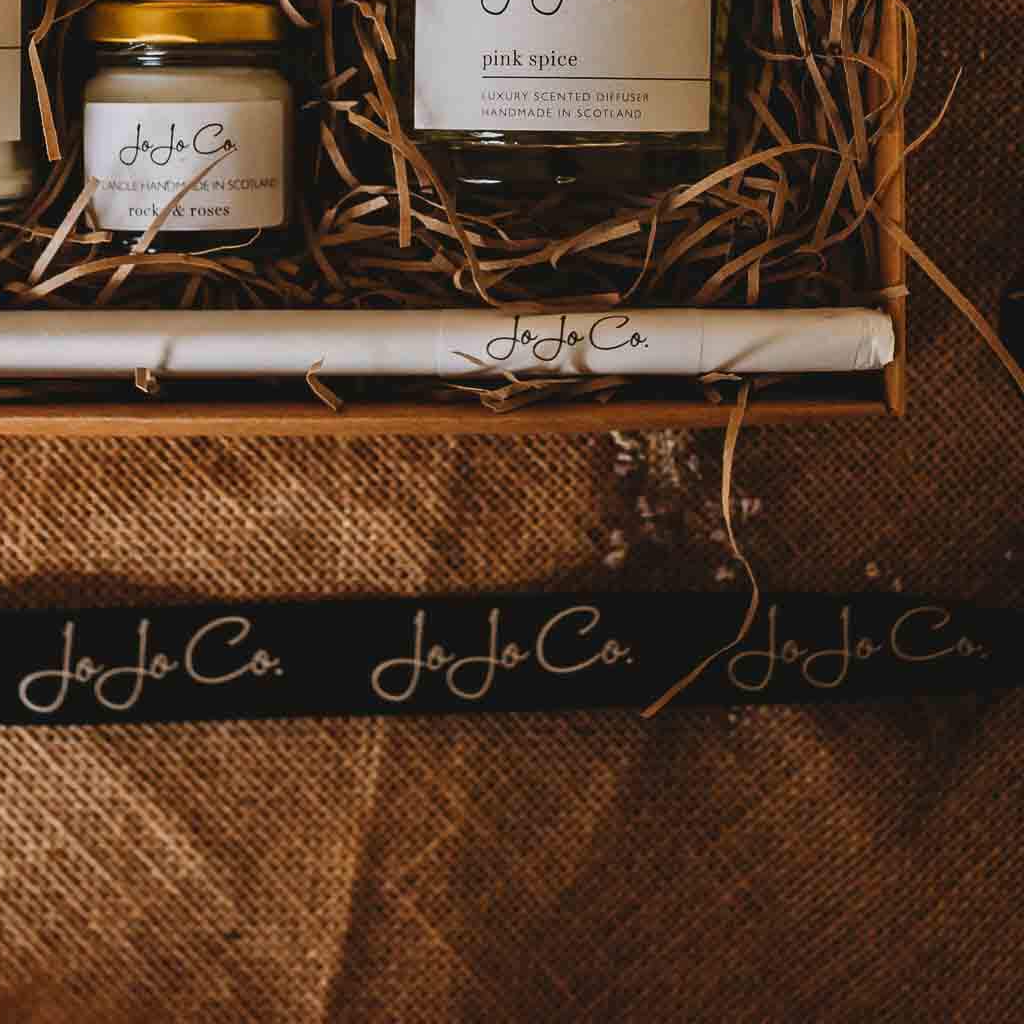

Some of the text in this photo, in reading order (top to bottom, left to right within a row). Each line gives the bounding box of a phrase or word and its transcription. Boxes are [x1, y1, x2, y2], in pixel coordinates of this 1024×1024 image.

[482, 49, 578, 70] pink spice
[481, 91, 650, 103] LUXURY SCENTED DIFFUSER
[481, 108, 642, 119] HANDMADE IN SCOTLAND
[192, 123, 239, 155] Co.
[213, 179, 225, 191] IN
[172, 205, 185, 217] &
[190, 205, 231, 217] roses
[589, 315, 649, 351] Co.
[534, 604, 634, 676] Co.
[889, 605, 994, 666] Co.
[184, 614, 284, 686] Co.
